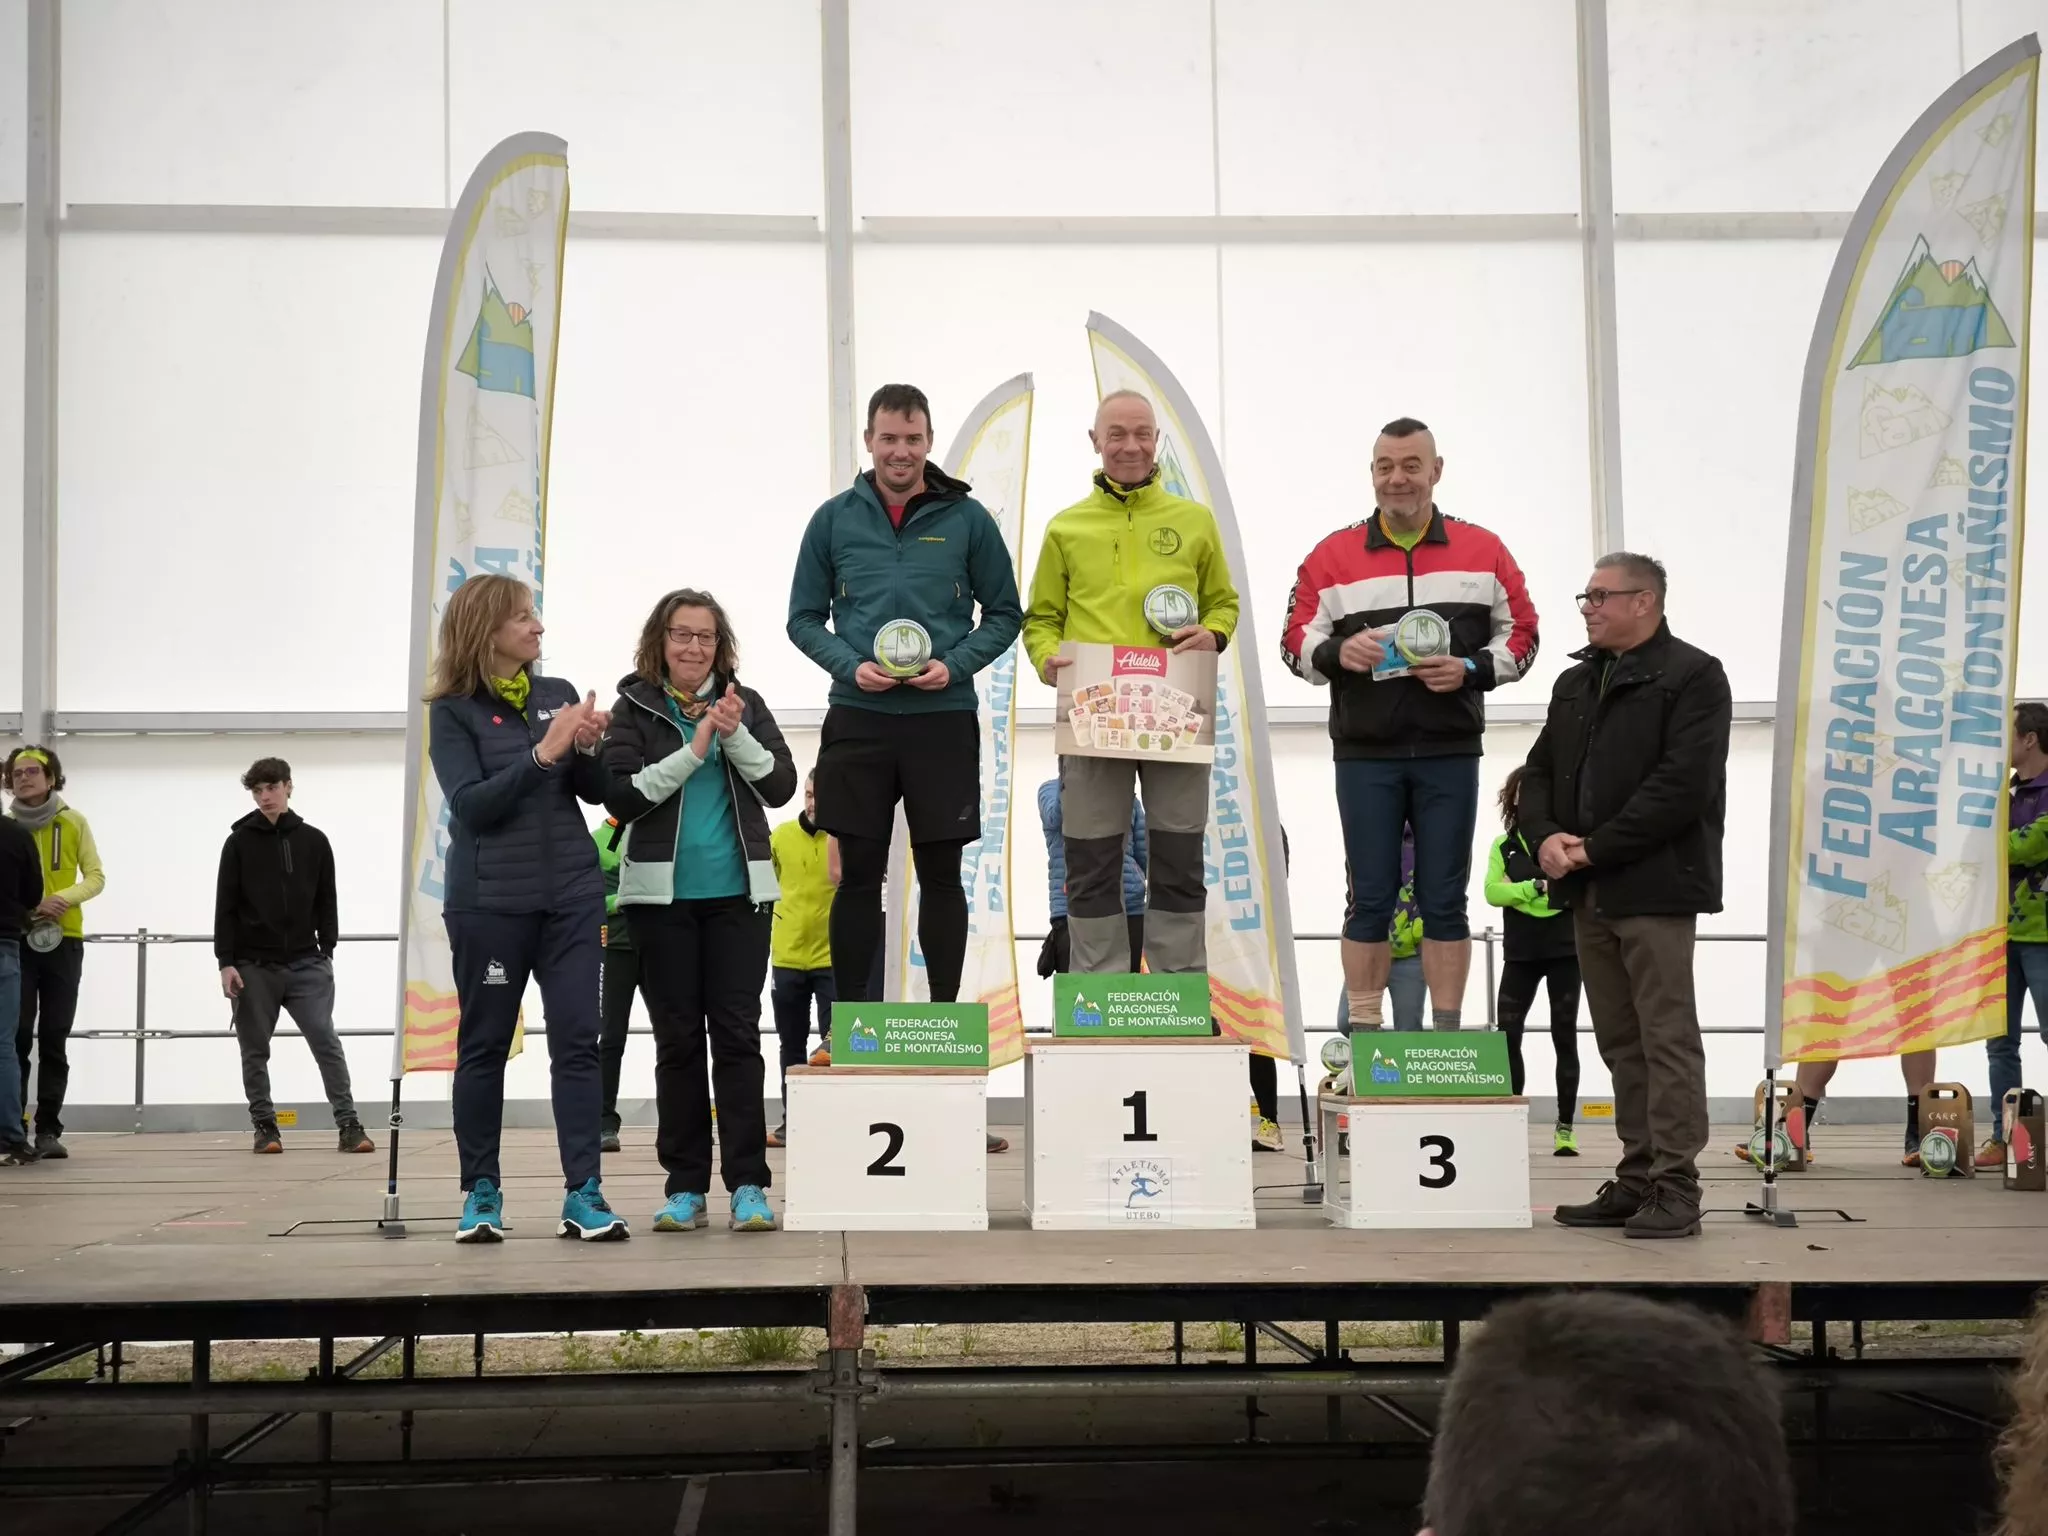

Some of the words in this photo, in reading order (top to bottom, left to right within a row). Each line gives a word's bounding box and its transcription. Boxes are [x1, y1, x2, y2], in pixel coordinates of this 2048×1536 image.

[1950, 366, 2016, 748] MONTAÑISMO
[1878, 513, 1949, 856] ARAGONESA
[1807, 551, 1888, 898] FEDERACIÓN
[1957, 757, 2003, 829] DE
[1107, 990, 1180, 1002] FEDERACIÓN
[1107, 1004, 1178, 1014] ARAGONESA
[885, 1017, 958, 1028] FEDERACIÓN
[1108, 1017, 1125, 1027] DE
[1128, 1015, 1206, 1026] MONTAÑISMO
[885, 1031, 956, 1041] ARAGONESA
[885, 1043, 901, 1053] DE
[904, 1042, 983, 1054] MONTAÑISMO
[1404, 1047, 1478, 1058] FEDERACIÓN
[1406, 1061, 1477, 1071] ARAGONESA
[1407, 1074, 1423, 1083] DE
[1426, 1072, 1505, 1084] MONTAÑISMO
[1123, 1090, 1157, 1141] 1
[867, 1122, 905, 1176] 2
[1418, 1134, 1457, 1188] 3
[1112, 1160, 1170, 1186] ATLETISMO
[1126, 1211, 1160, 1220] UTEBO
